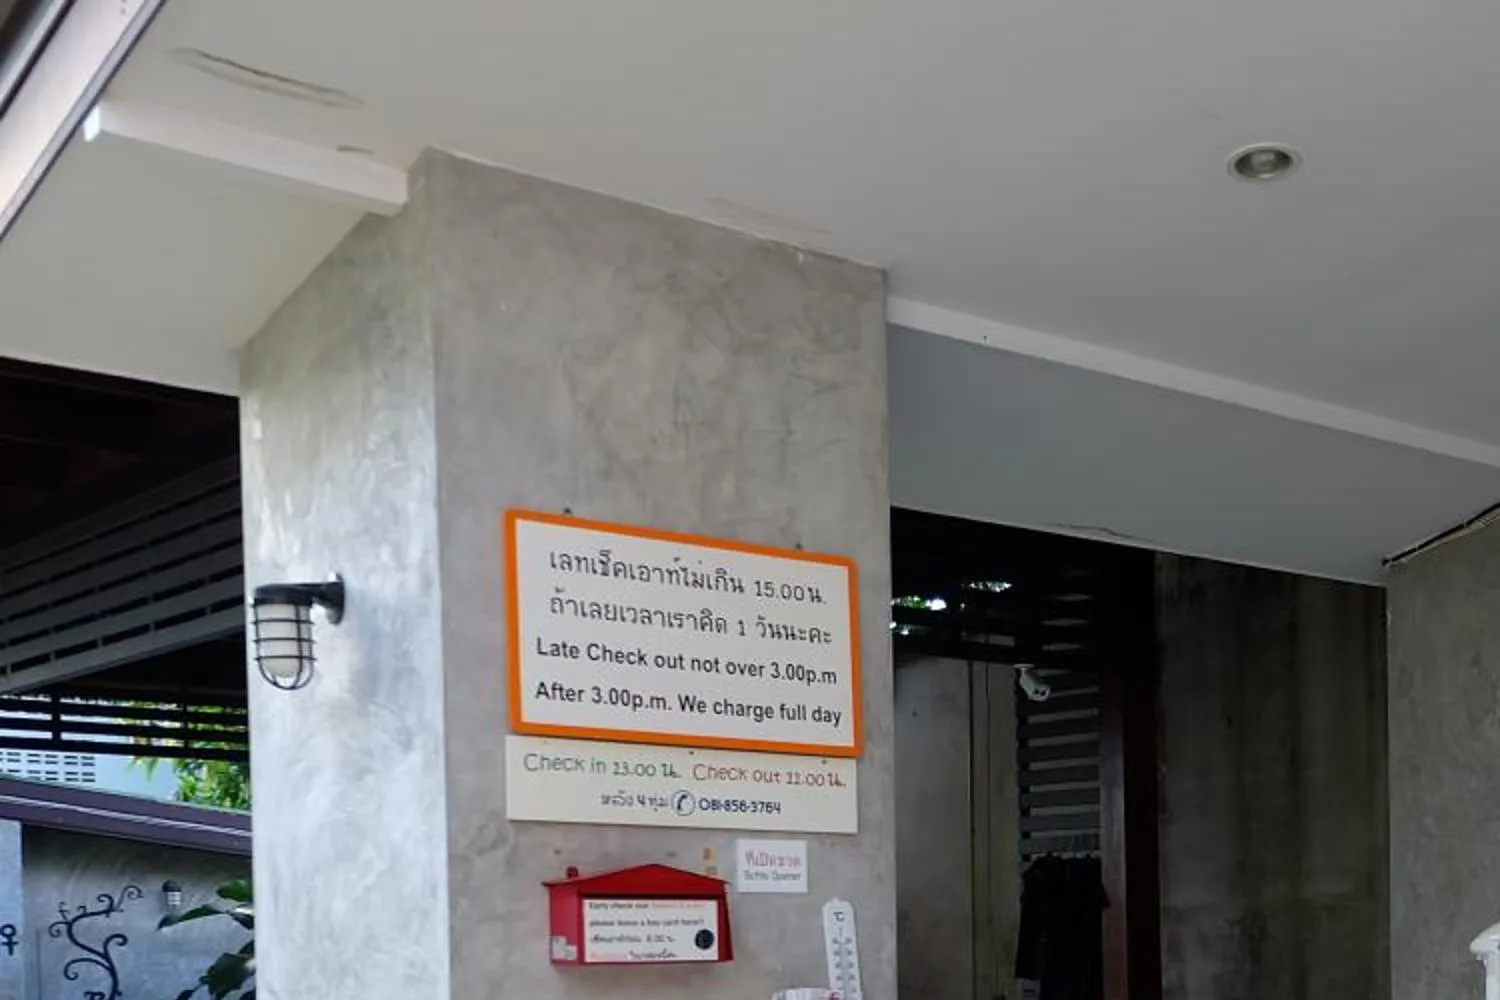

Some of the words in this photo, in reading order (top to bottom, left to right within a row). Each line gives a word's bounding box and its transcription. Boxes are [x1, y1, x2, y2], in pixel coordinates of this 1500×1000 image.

[738, 619, 746, 637] 1
[756, 614, 832, 644] วันนะคะ
[536, 636, 580, 659] Late
[587, 643, 648, 666] Check
[654, 653, 685, 670] out
[691, 657, 720, 673] not
[725, 661, 765, 677] over
[536, 681, 585, 702] After
[591, 686, 672, 711] 3.00p.m.
[678, 693, 707, 712] We
[713, 698, 774, 723] charge
[780, 703, 807, 721] full
[811, 706, 842, 728] day
[523, 753, 585, 772] Check
[590, 757, 607, 774] in
[693, 763, 747, 781] Check
[752, 769, 781, 784] out
